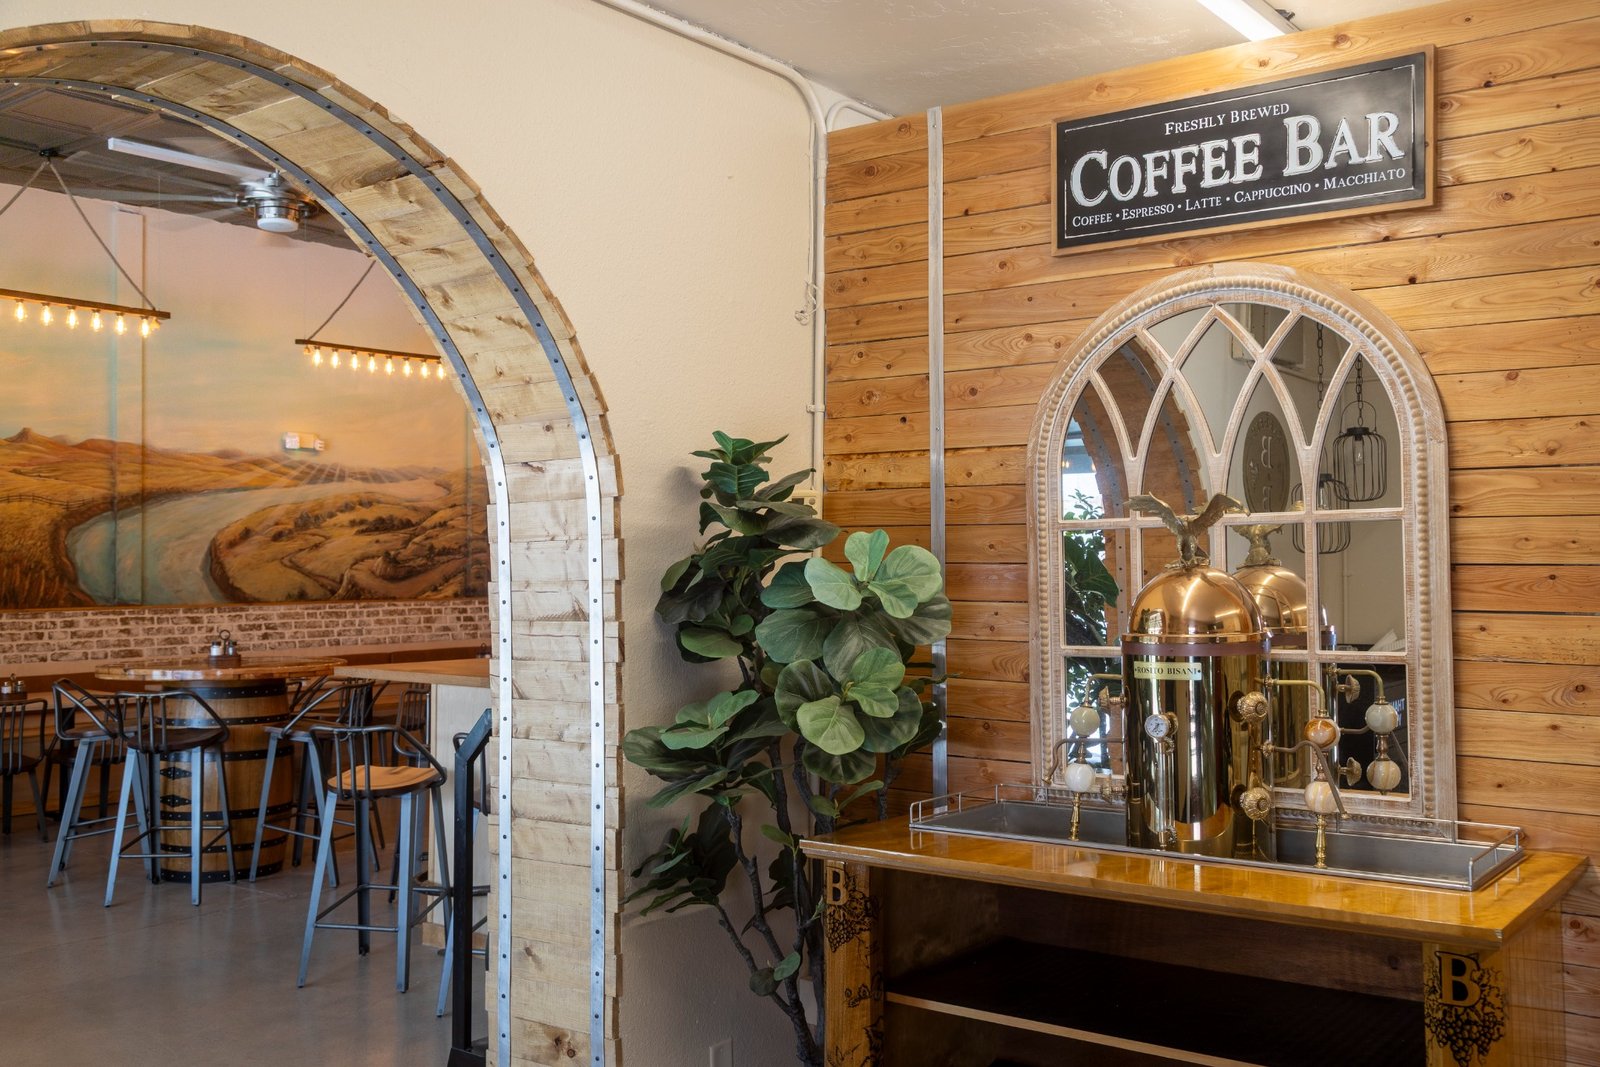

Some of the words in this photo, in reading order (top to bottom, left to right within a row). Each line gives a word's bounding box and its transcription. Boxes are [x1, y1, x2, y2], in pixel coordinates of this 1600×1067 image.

[1165, 114, 1226, 135] FRESHLY
[1231, 103, 1289, 123] BREWED
[1070, 132, 1263, 208] COFFEE
[1283, 112, 1405, 176] BAR
[1072, 213, 1112, 227] COFFEE
[1122, 204, 1174, 220] ESPRESSO
[1186, 196, 1221, 211] LATTE
[1234, 183, 1311, 203] CAPPUCCINO
[1324, 168, 1405, 190] MACCHIATO
[1435, 950, 1482, 1008] B
